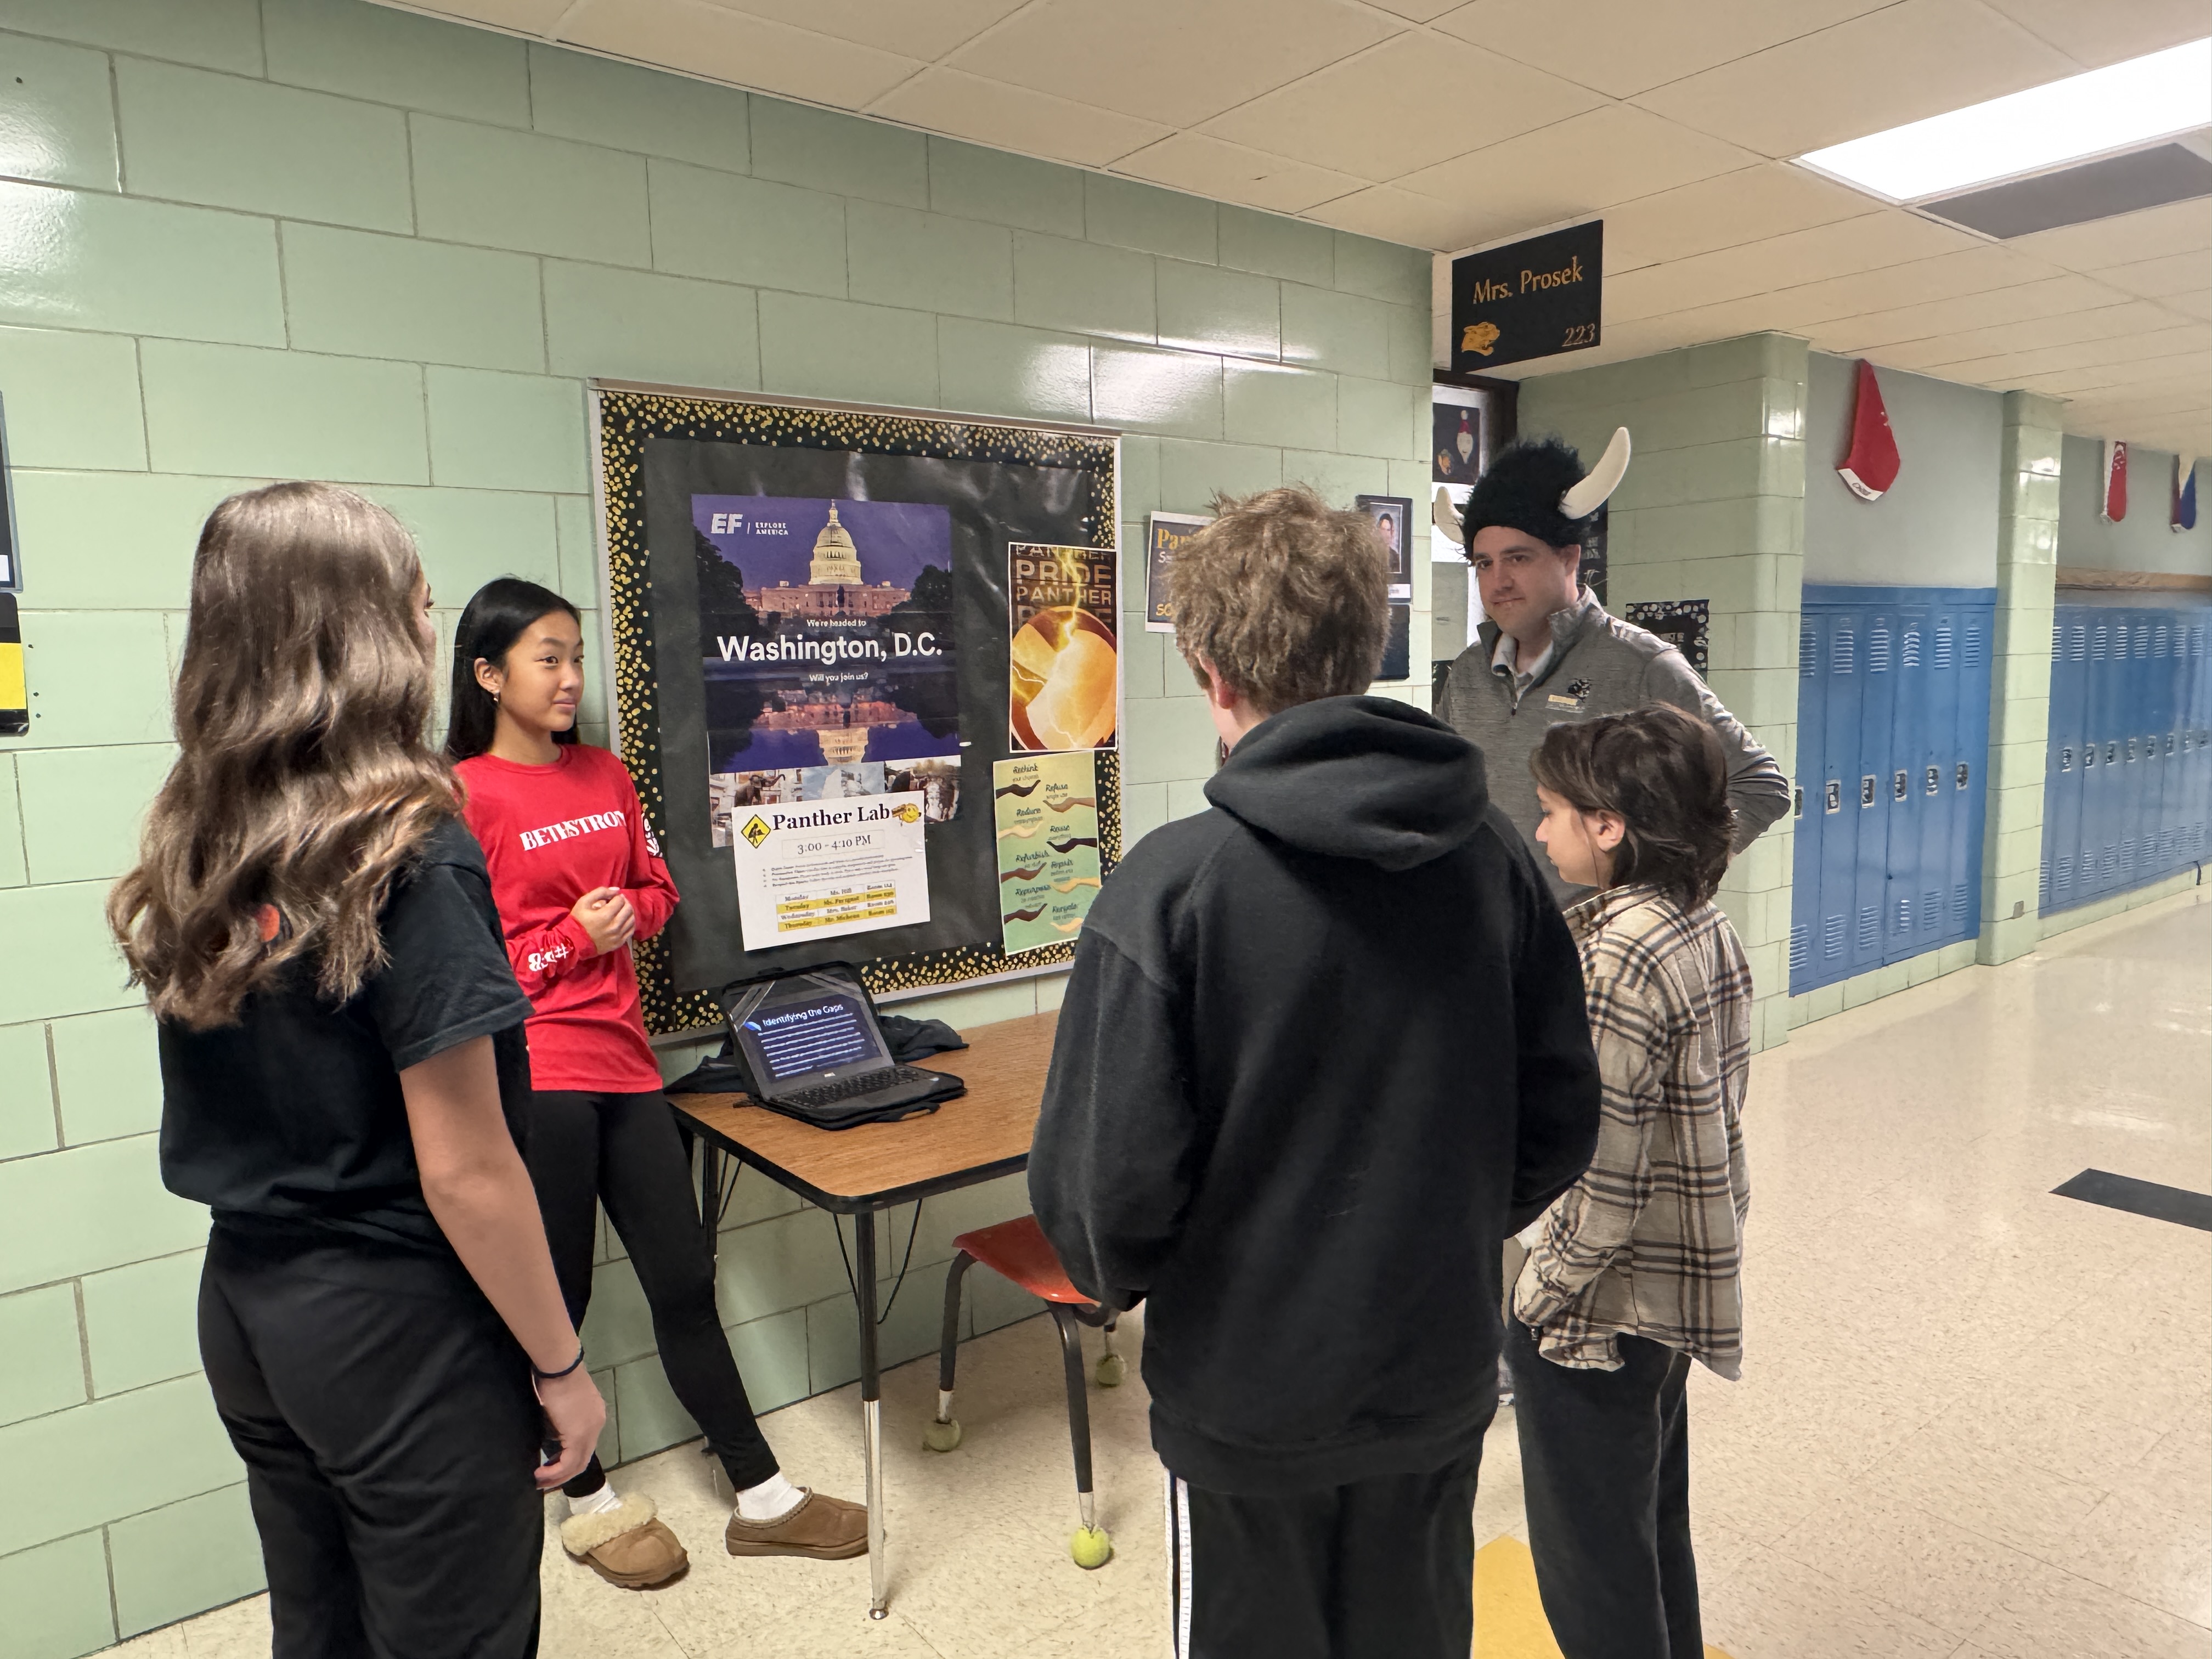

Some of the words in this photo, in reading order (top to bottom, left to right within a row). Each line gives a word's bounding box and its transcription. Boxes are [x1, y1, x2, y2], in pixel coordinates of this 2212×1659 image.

[1473, 279, 1513, 304] Mrs.
[1520, 256, 1583, 294] Prosek
[1562, 323, 1595, 347] 223
[711, 513, 743, 534] EF
[1016, 560, 1111, 588] PRIDE
[1017, 586, 1111, 605] PANTHER
[717, 634, 887, 665] Washington,
[894, 632, 943, 657] D.C.
[825, 675, 839, 685] you
[840, 673, 854, 682] join
[856, 672, 868, 680] us?
[773, 809, 852, 831] Panther
[857, 804, 889, 822] Lab
[798, 842, 822, 855] 3:00
[831, 839, 853, 850] 4:10
[855, 834, 871, 845] PM
[763, 1012, 808, 1026] Identifying
